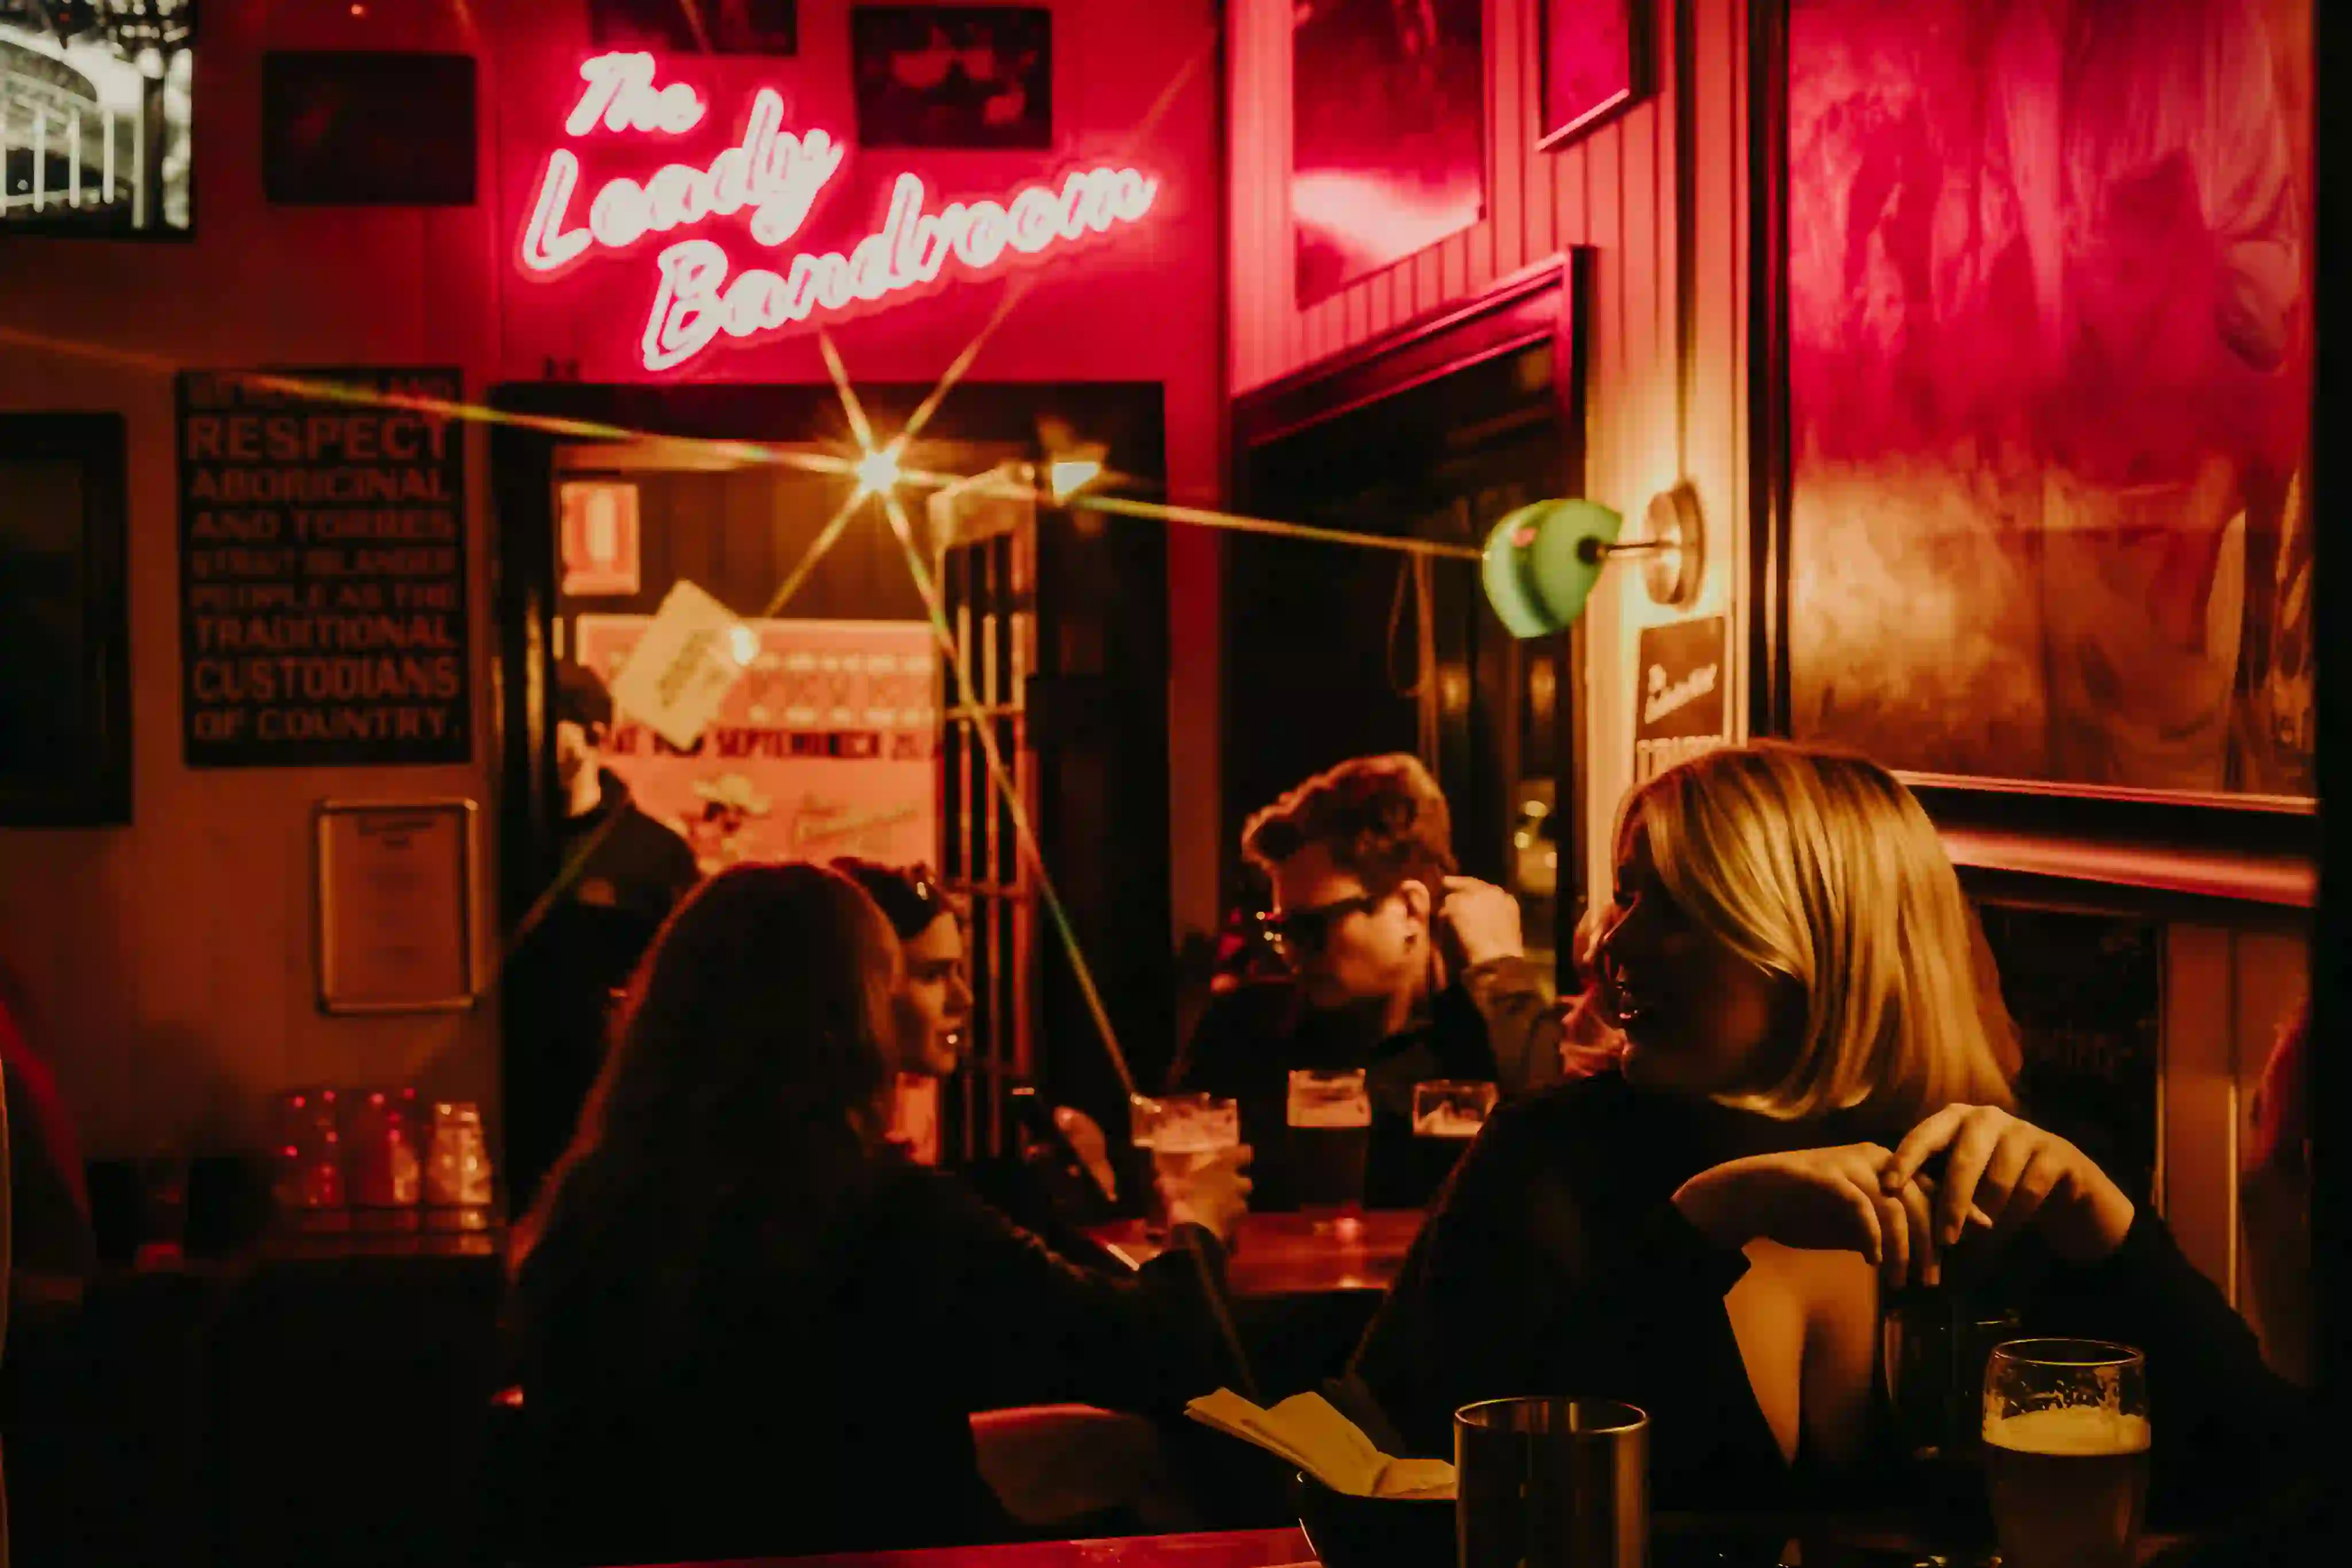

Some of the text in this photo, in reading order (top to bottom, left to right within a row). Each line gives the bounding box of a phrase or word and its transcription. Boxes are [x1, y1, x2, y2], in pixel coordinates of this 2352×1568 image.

[566, 51, 706, 137] The
[641, 168, 1159, 371] Bandroom
[187, 413, 454, 460] RESPECT
[191, 466, 451, 501] ABORIGINAL
[191, 509, 456, 540] AND TORRES
[195, 614, 458, 649] TRADITIONAL
[193, 656, 460, 702] CUSTODIANS
[194, 707, 246, 741] OF
